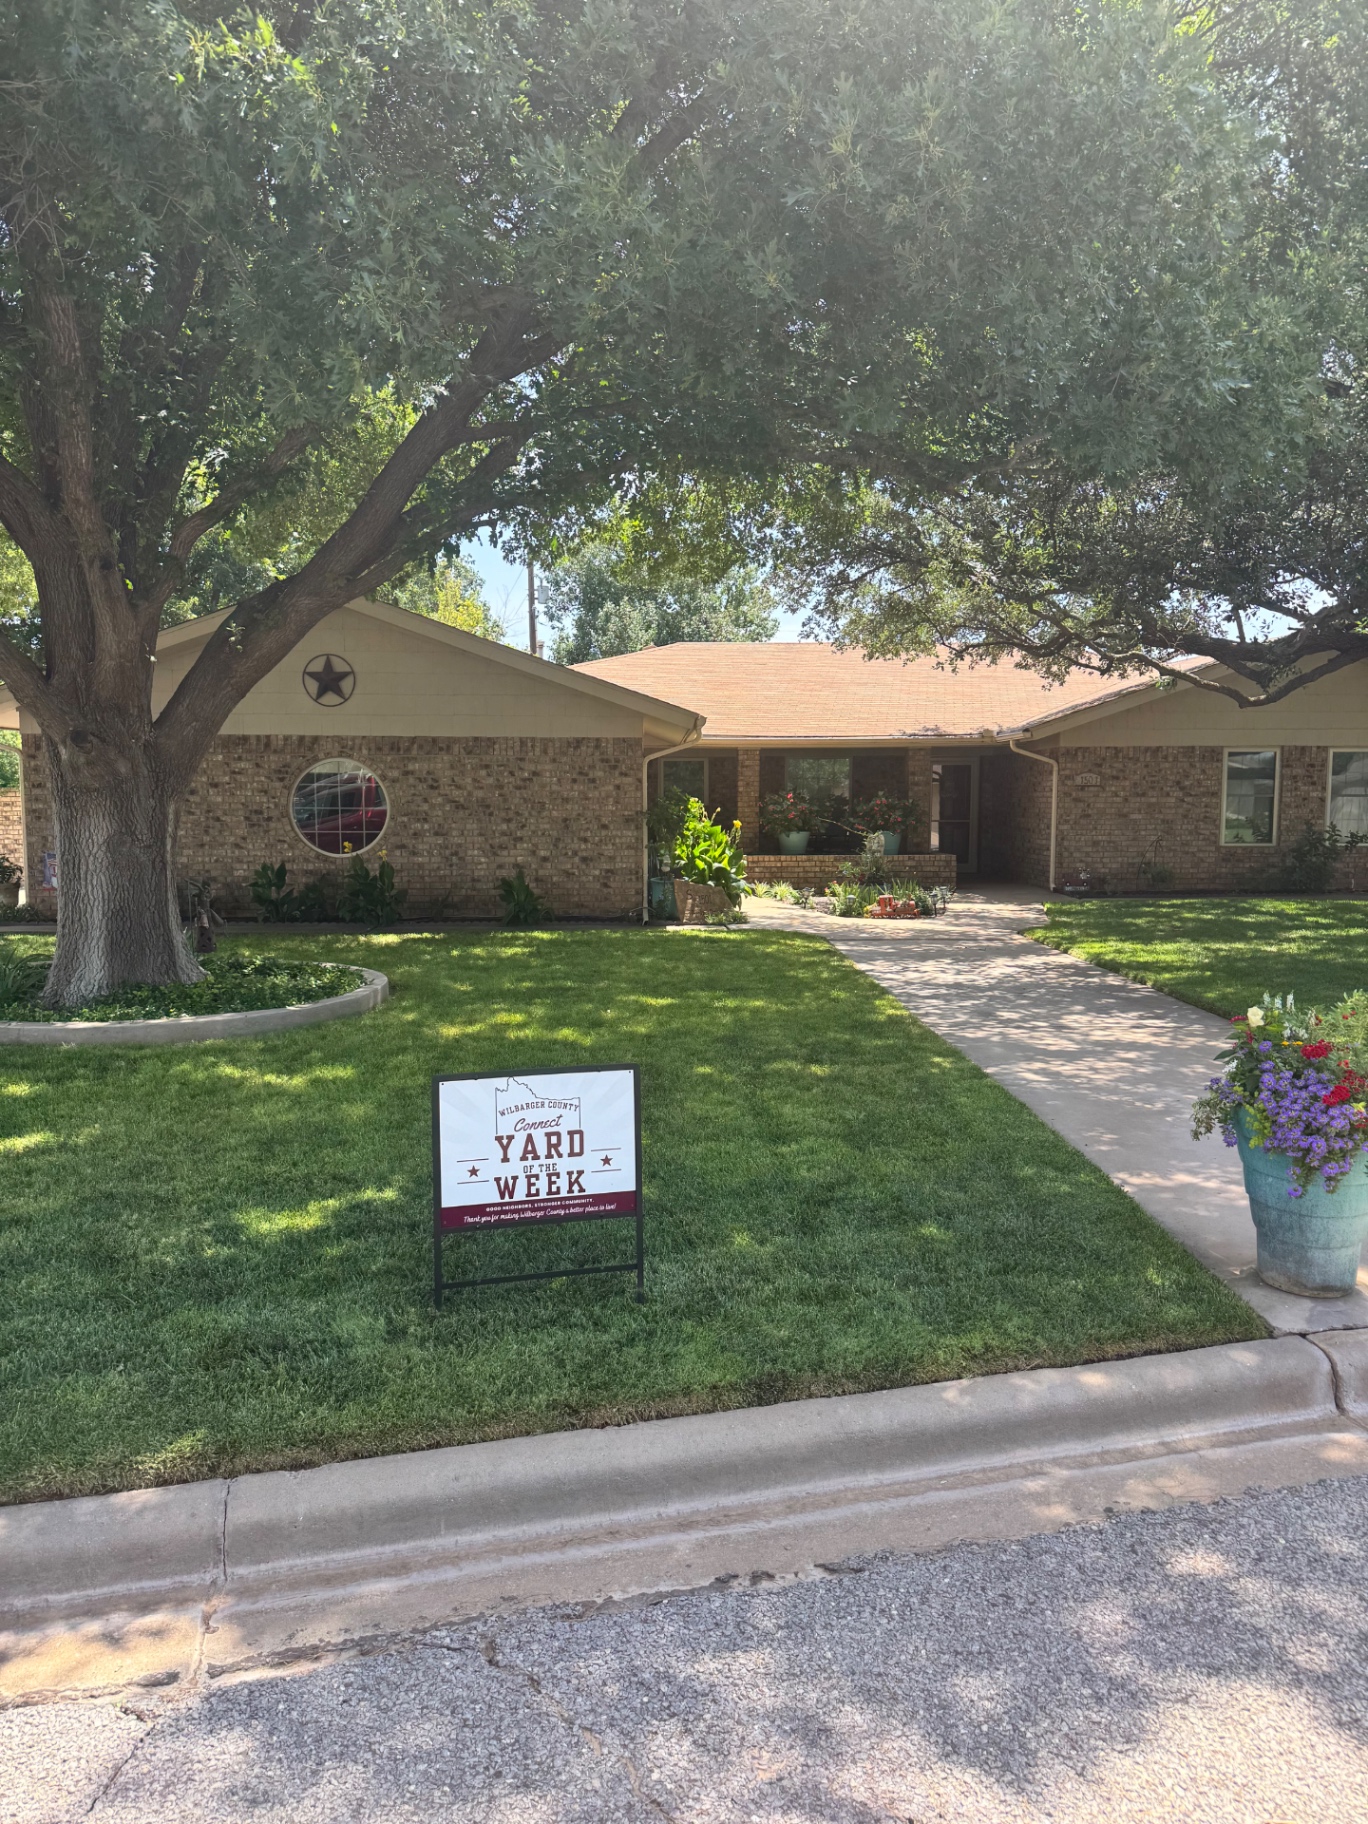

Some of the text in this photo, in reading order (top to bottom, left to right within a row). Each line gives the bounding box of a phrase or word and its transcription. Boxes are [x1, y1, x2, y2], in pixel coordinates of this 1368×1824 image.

[498, 1101, 580, 1116] WILBARGER COUNTY
[514, 1114, 563, 1132] Connect
[495, 1130, 584, 1163] YARD
[523, 1163, 558, 1174] OF THE
[494, 1170, 587, 1200] WEEK
[500, 1212, 519, 1220] making
[520, 1210, 544, 1218] Wilbarger
[546, 1208, 565, 1216] County
[585, 1204, 598, 1213] place
